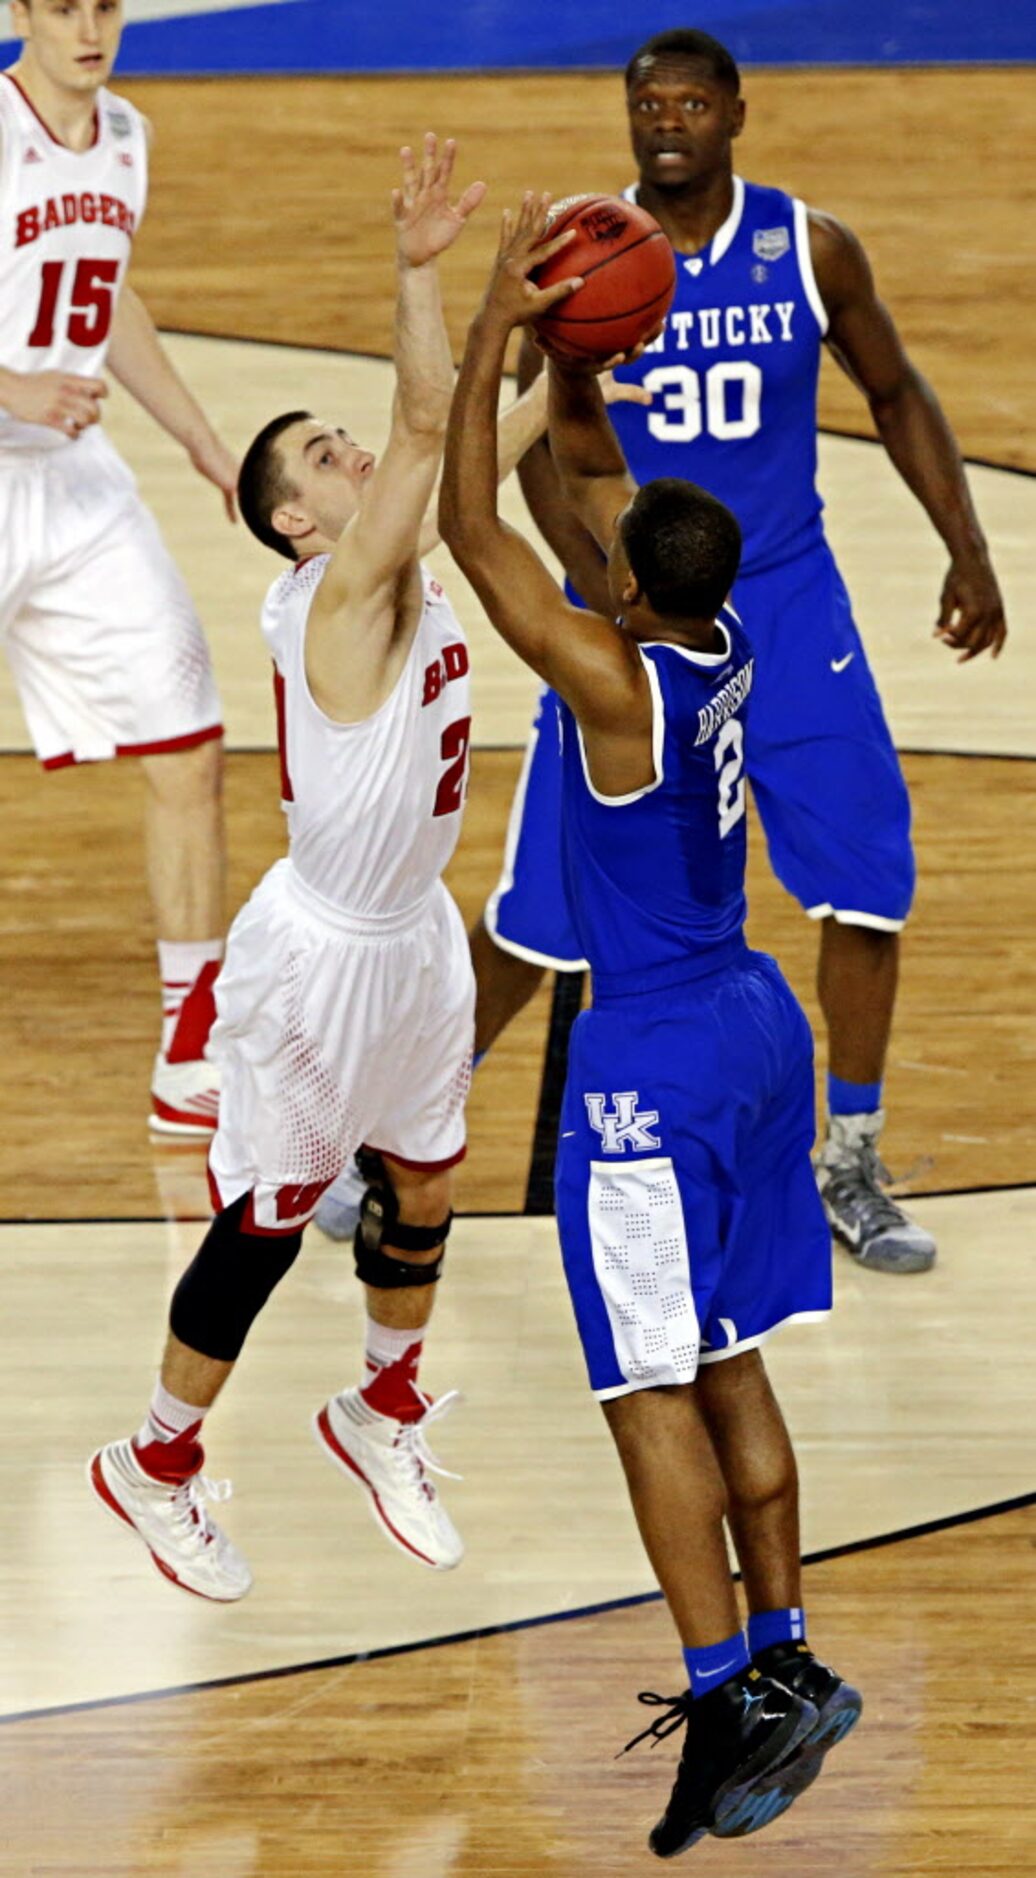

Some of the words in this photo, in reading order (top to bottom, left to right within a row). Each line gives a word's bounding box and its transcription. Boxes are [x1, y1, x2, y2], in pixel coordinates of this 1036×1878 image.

[27, 258, 119, 348] 15
[643, 361, 762, 443] 30
[693, 657, 755, 748] HARRISON
[713, 718, 747, 840] 2
[584, 1091, 661, 1154] UK
